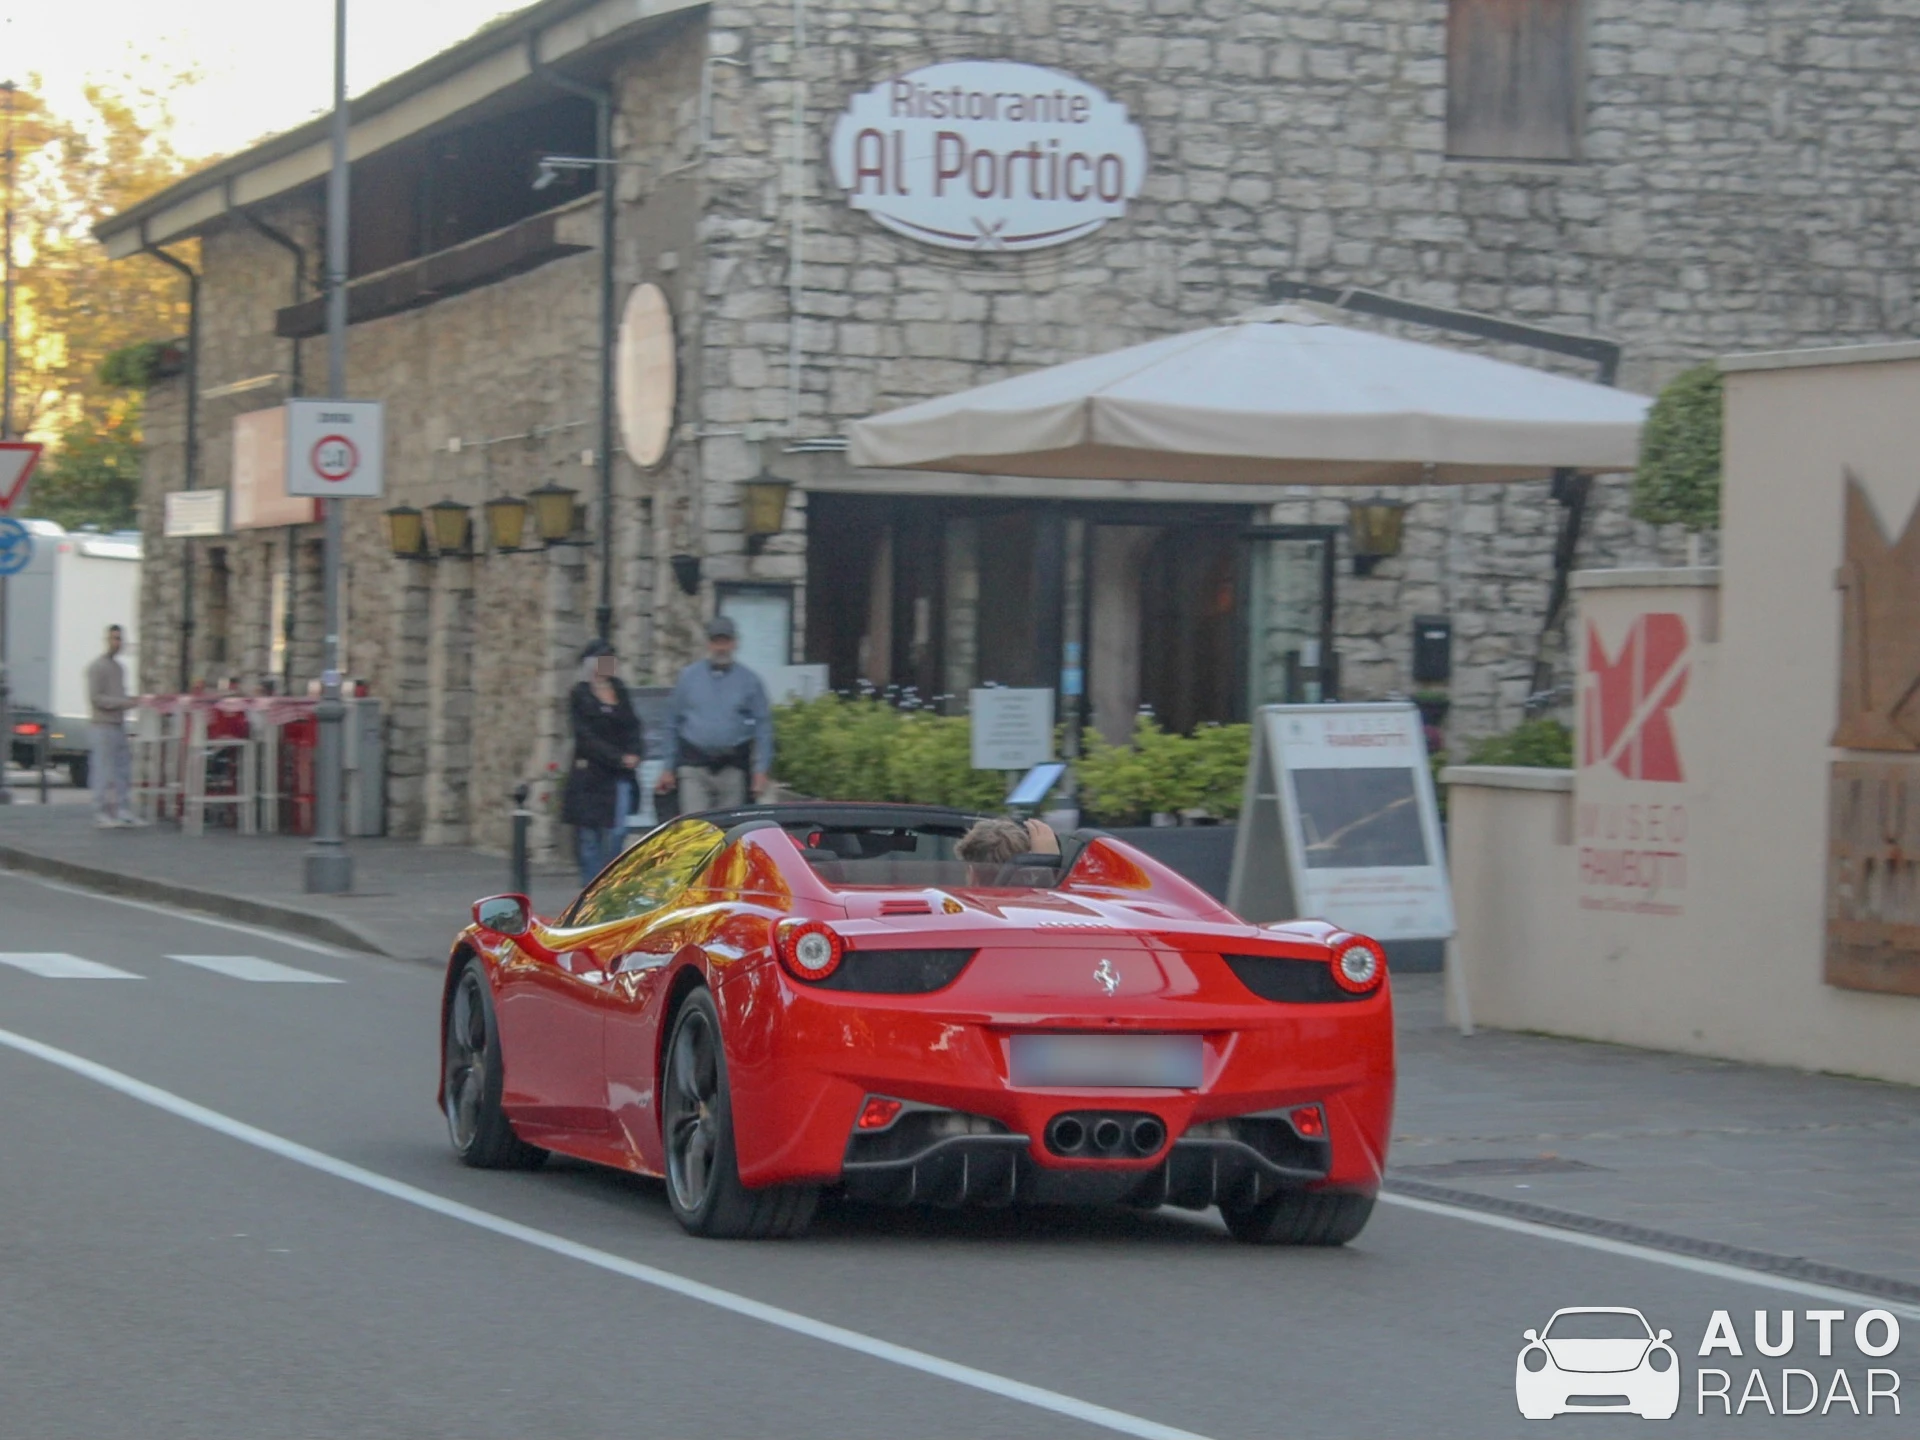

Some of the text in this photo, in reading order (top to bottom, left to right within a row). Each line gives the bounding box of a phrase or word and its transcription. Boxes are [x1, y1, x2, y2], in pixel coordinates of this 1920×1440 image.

[890, 79, 1090, 124] Ristorante
[855, 127, 1125, 203] Al Portico
